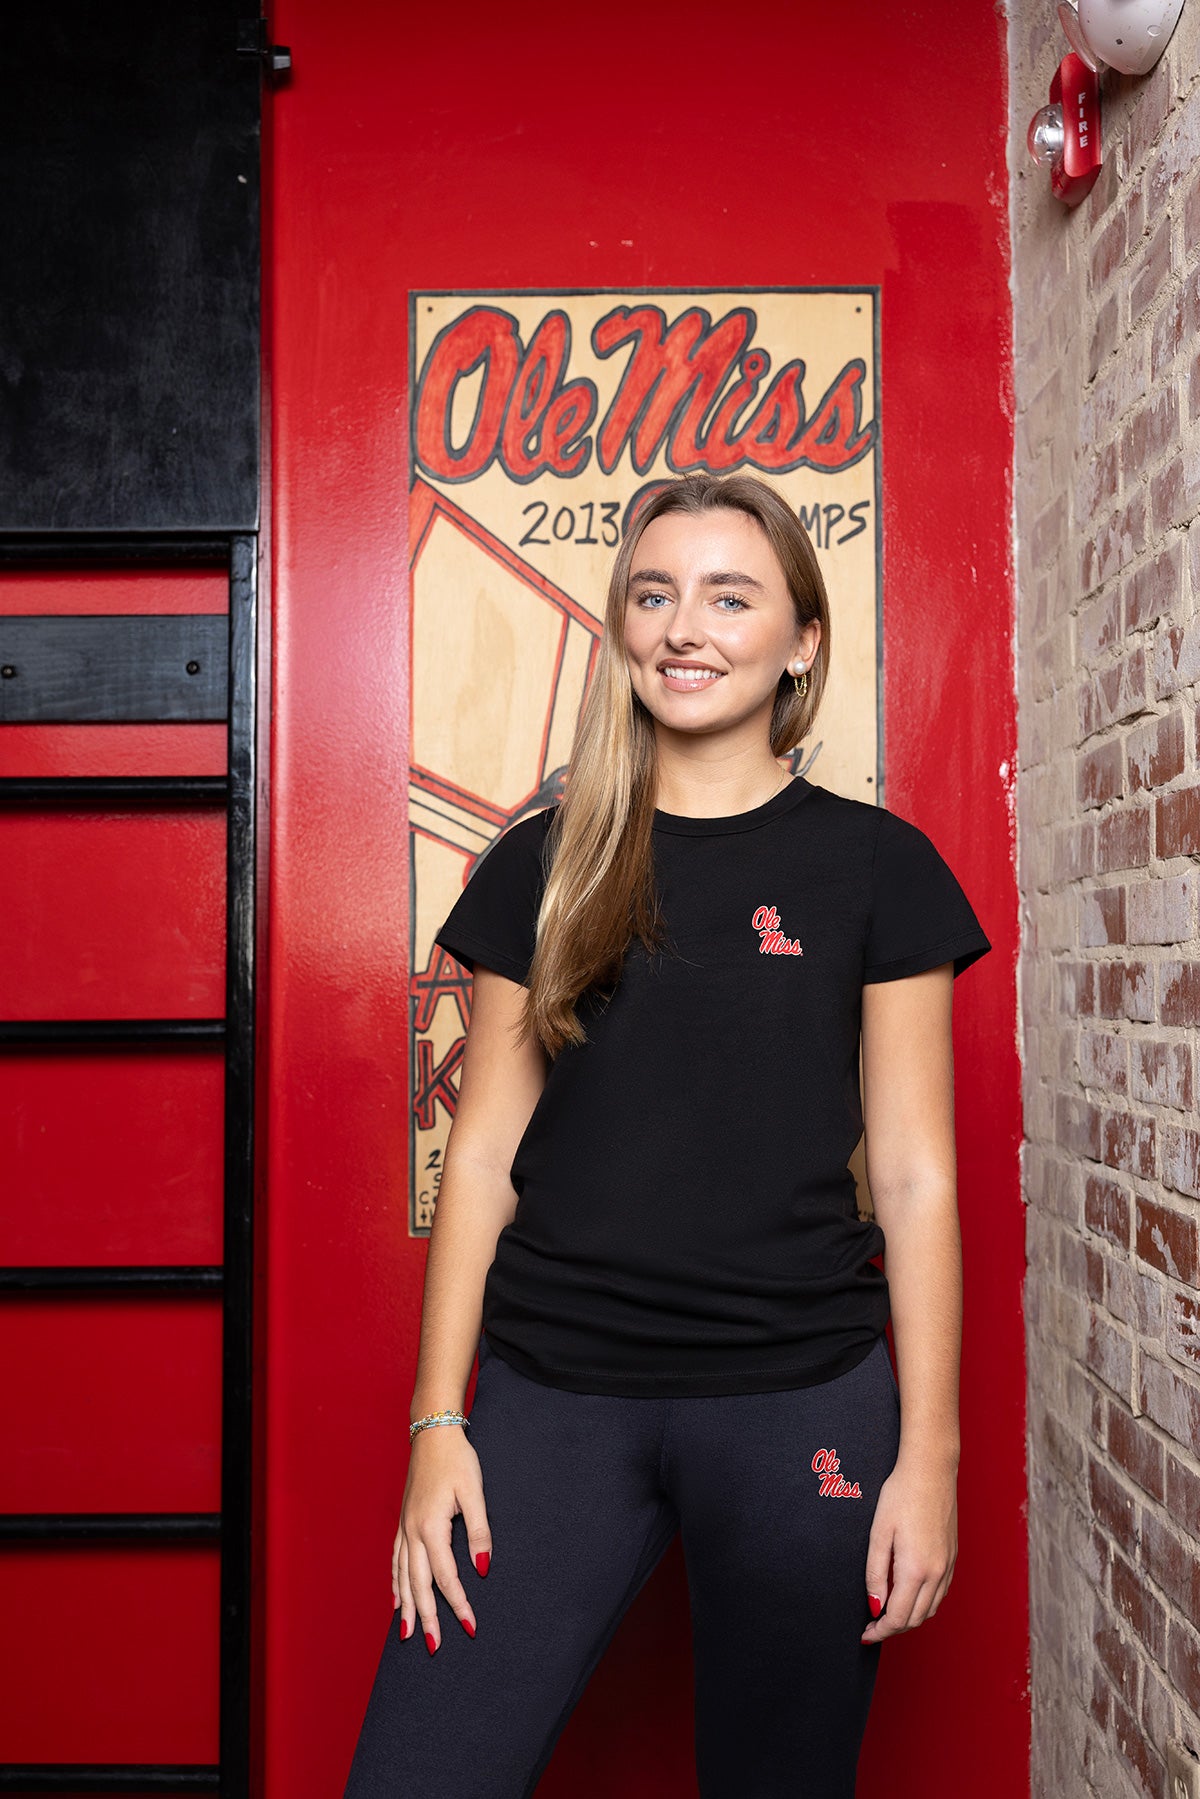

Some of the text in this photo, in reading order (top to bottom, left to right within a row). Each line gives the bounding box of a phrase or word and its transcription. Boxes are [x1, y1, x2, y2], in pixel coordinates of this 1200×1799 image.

[1078, 92, 1089, 149] FIRE
[414, 304, 878, 485] Ole Miss
[518, 500, 621, 548] 2013
[798, 500, 871, 550] MPS
[751, 905, 803, 956] Ole Miss
[811, 1448, 862, 1498] Ole Miss
